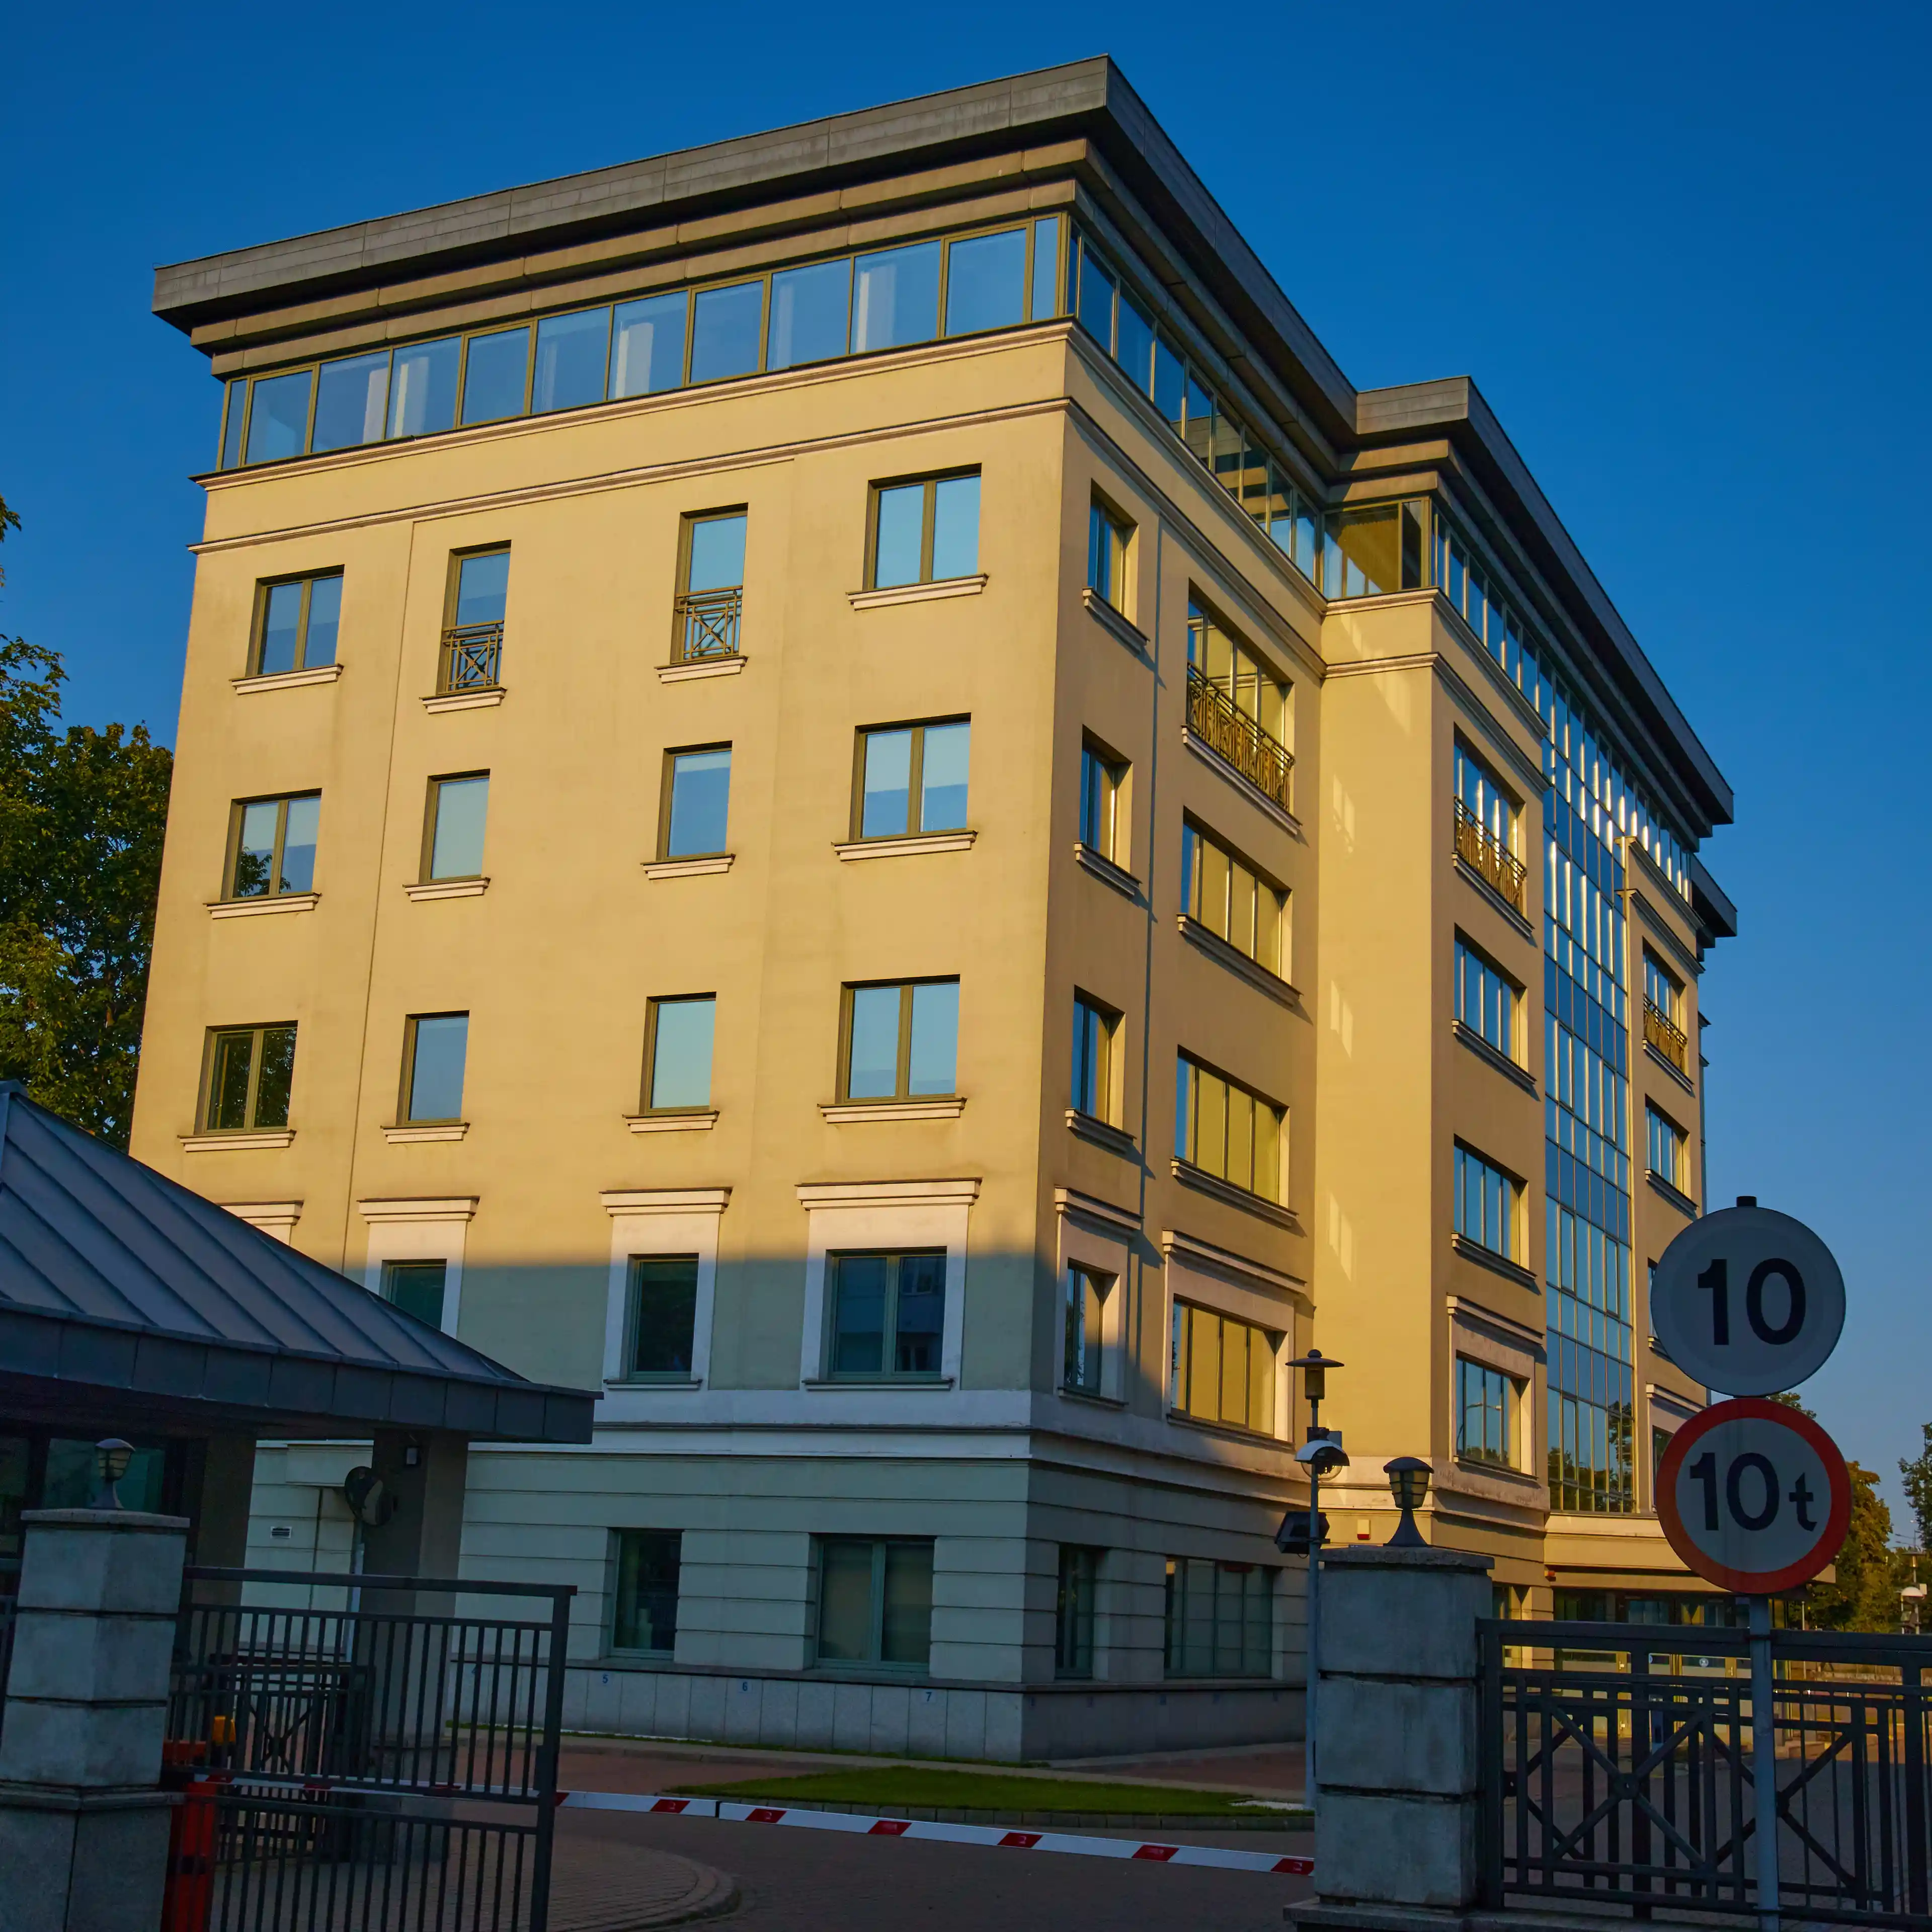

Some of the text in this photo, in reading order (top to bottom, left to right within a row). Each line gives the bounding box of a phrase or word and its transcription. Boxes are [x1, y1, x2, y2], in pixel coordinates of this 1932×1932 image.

[1698, 1258, 1806, 1345] 10
[602, 1674, 608, 1684] 5
[742, 1682, 748, 1691] 6
[926, 1692, 932, 1702] 7
